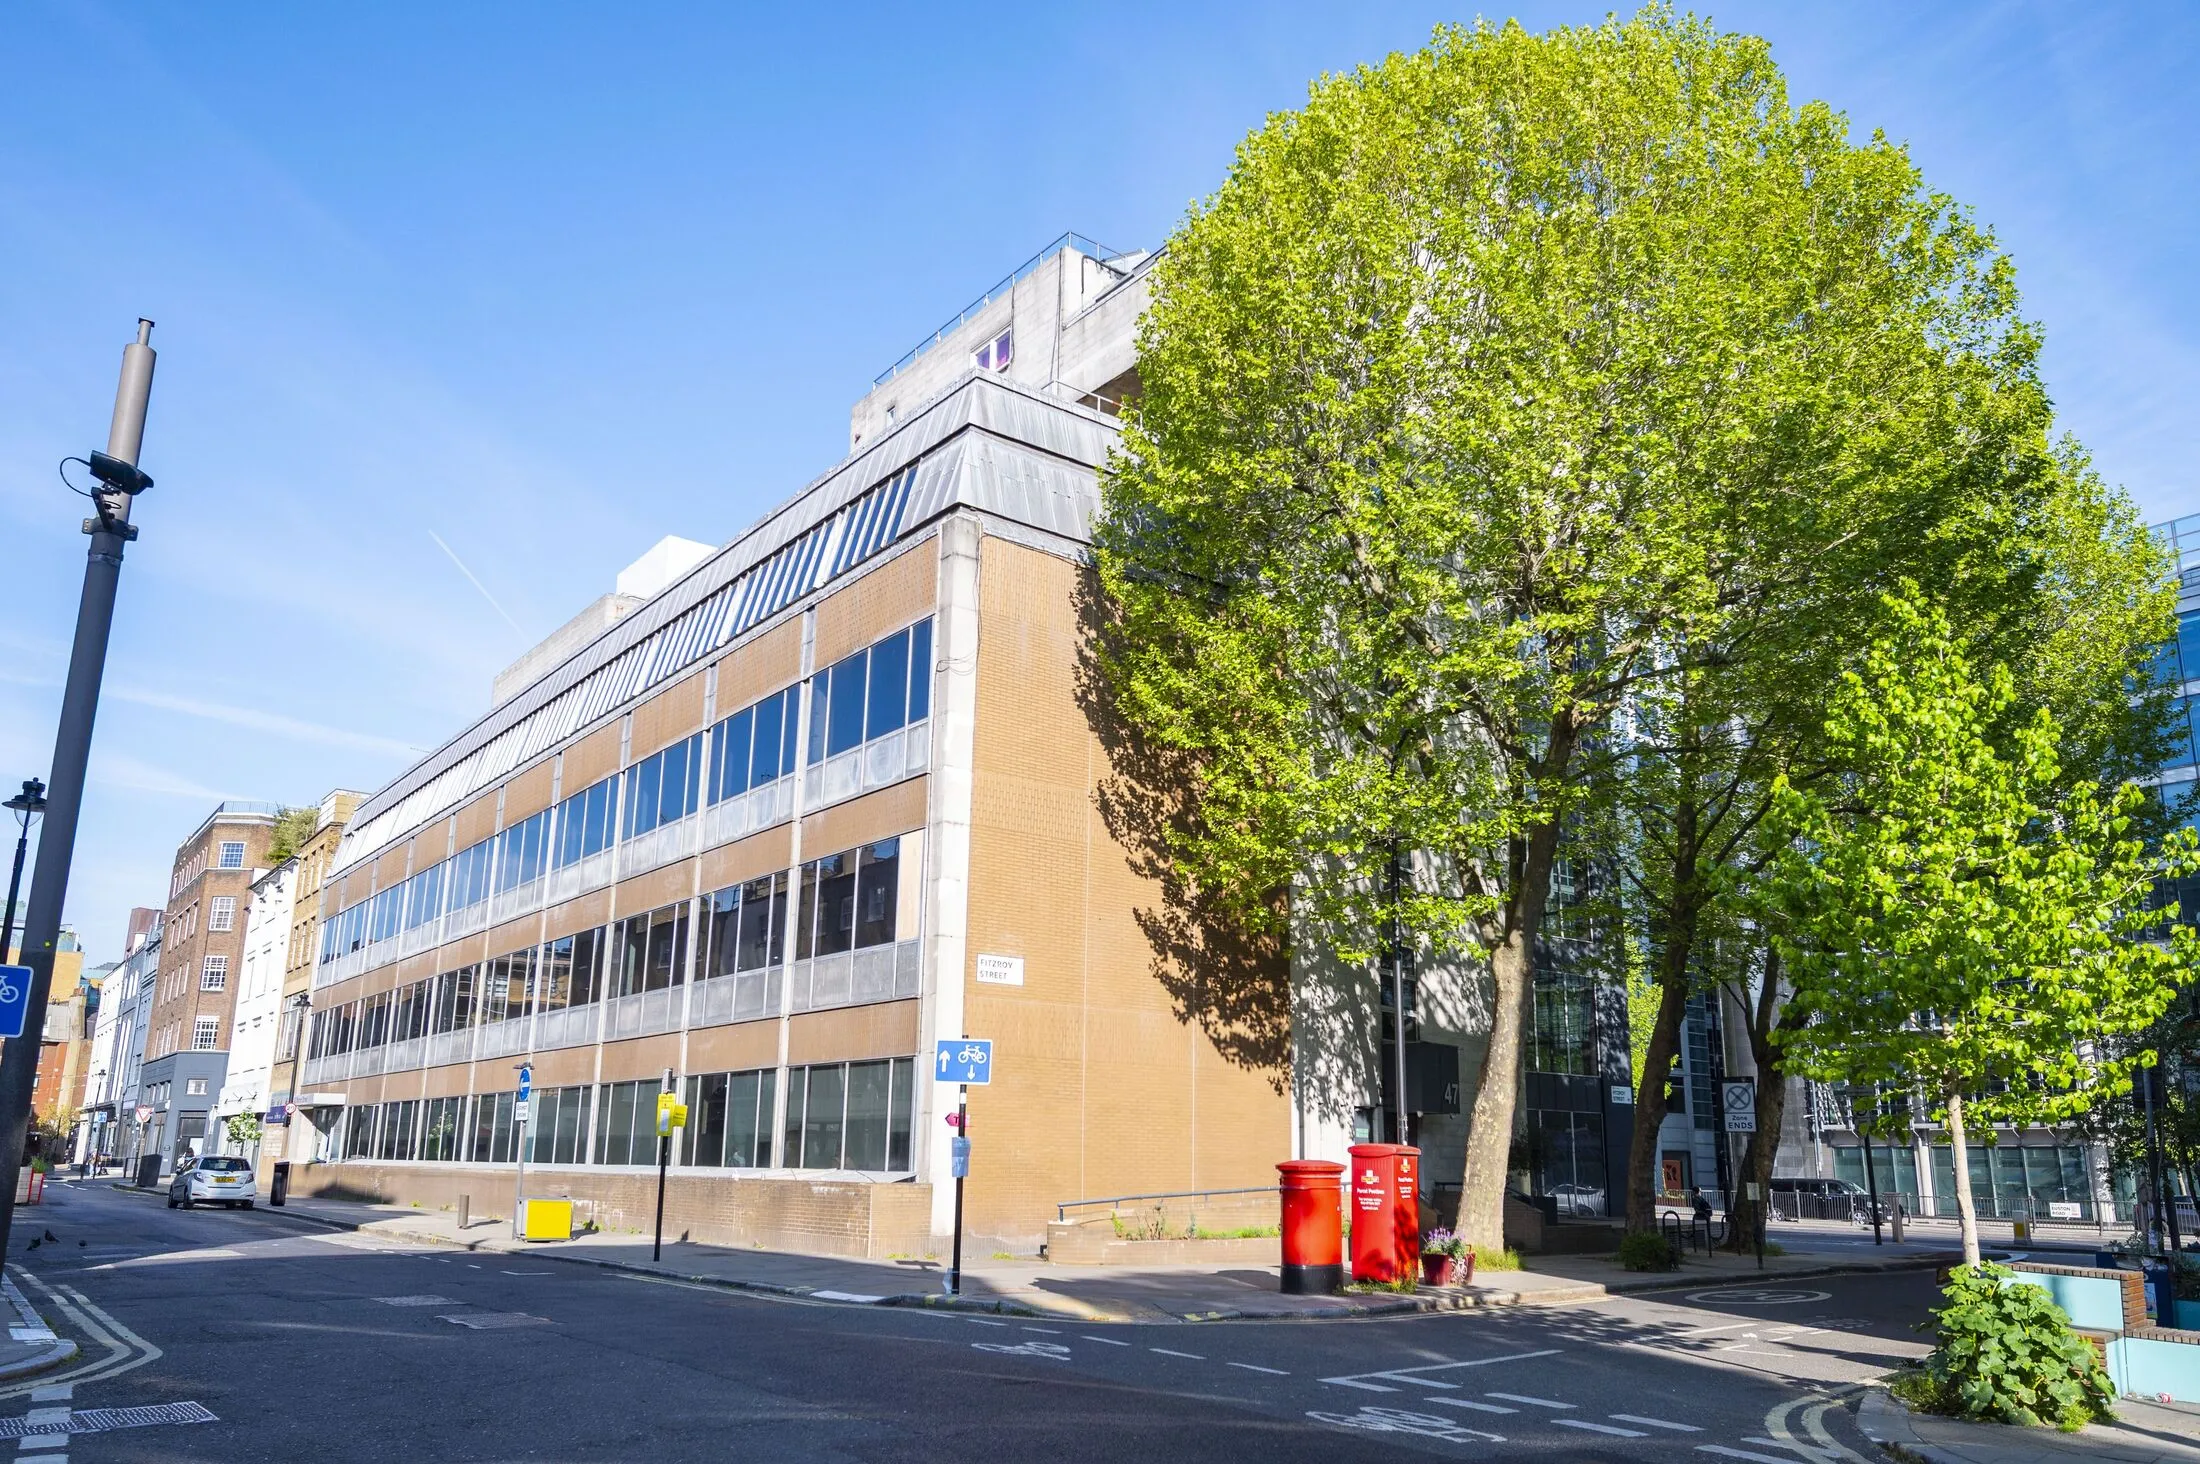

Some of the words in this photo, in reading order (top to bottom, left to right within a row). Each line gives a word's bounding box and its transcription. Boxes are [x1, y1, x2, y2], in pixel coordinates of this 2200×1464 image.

[980, 958, 1012, 969] FITZROY
[980, 970, 1007, 980] STREET
[1444, 1082, 1459, 1105] 47
